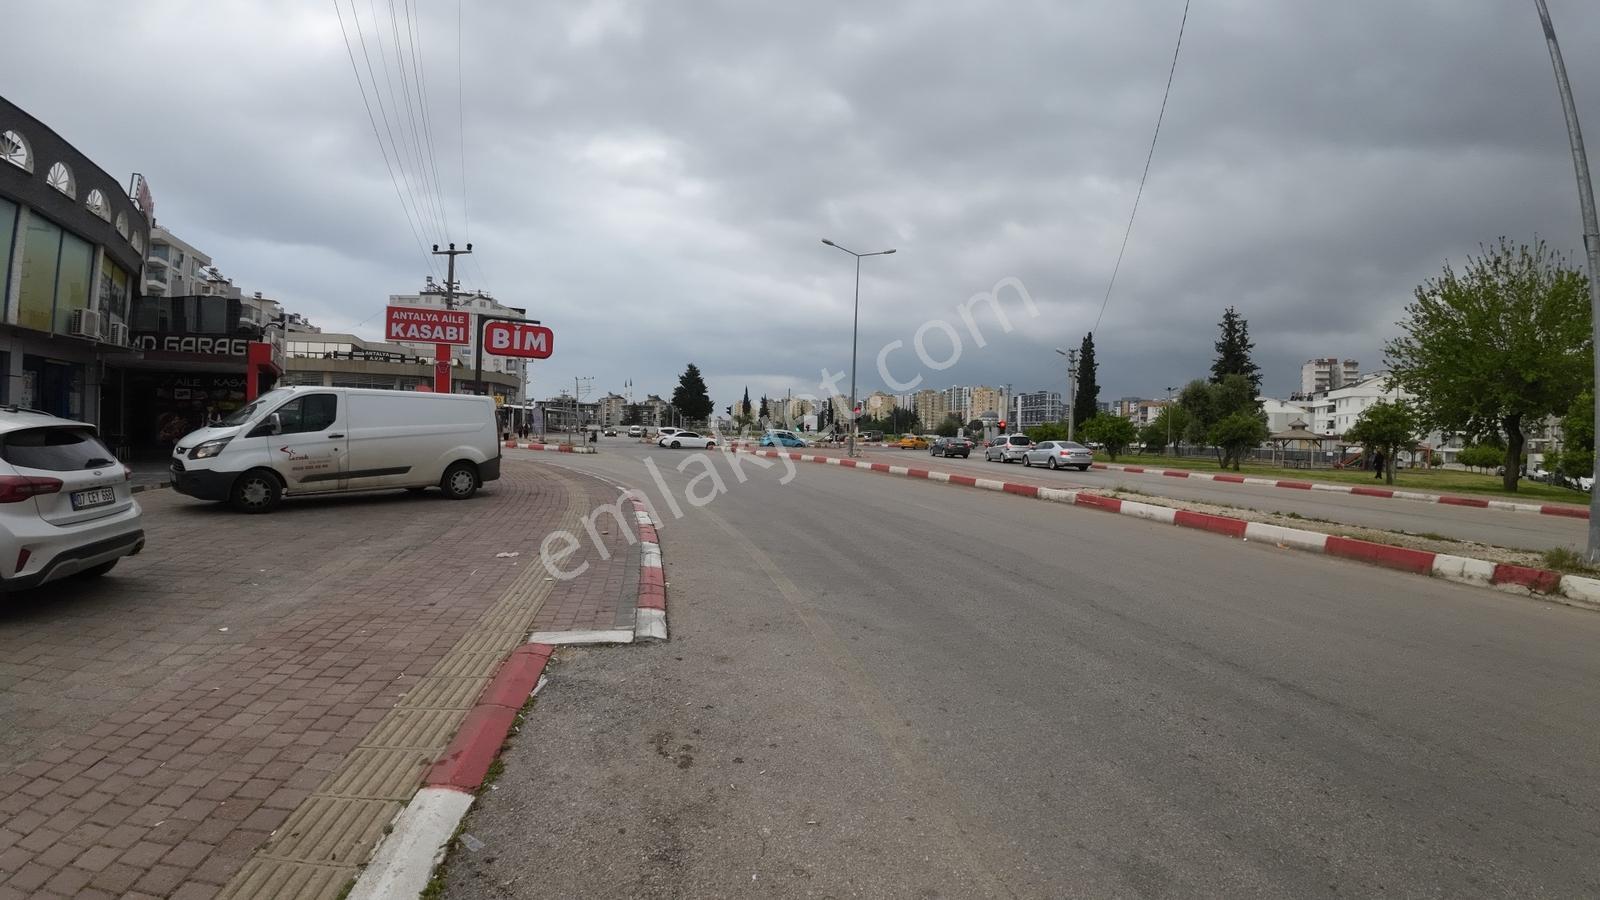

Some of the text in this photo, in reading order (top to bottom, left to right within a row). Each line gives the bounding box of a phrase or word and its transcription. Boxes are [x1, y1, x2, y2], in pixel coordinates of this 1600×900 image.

[392, 311, 465, 324] ANTALYA AİLE
[391, 322, 465, 341] KASABI
[492, 324, 547, 352] BİM
[77, 493, 85, 505] 07
